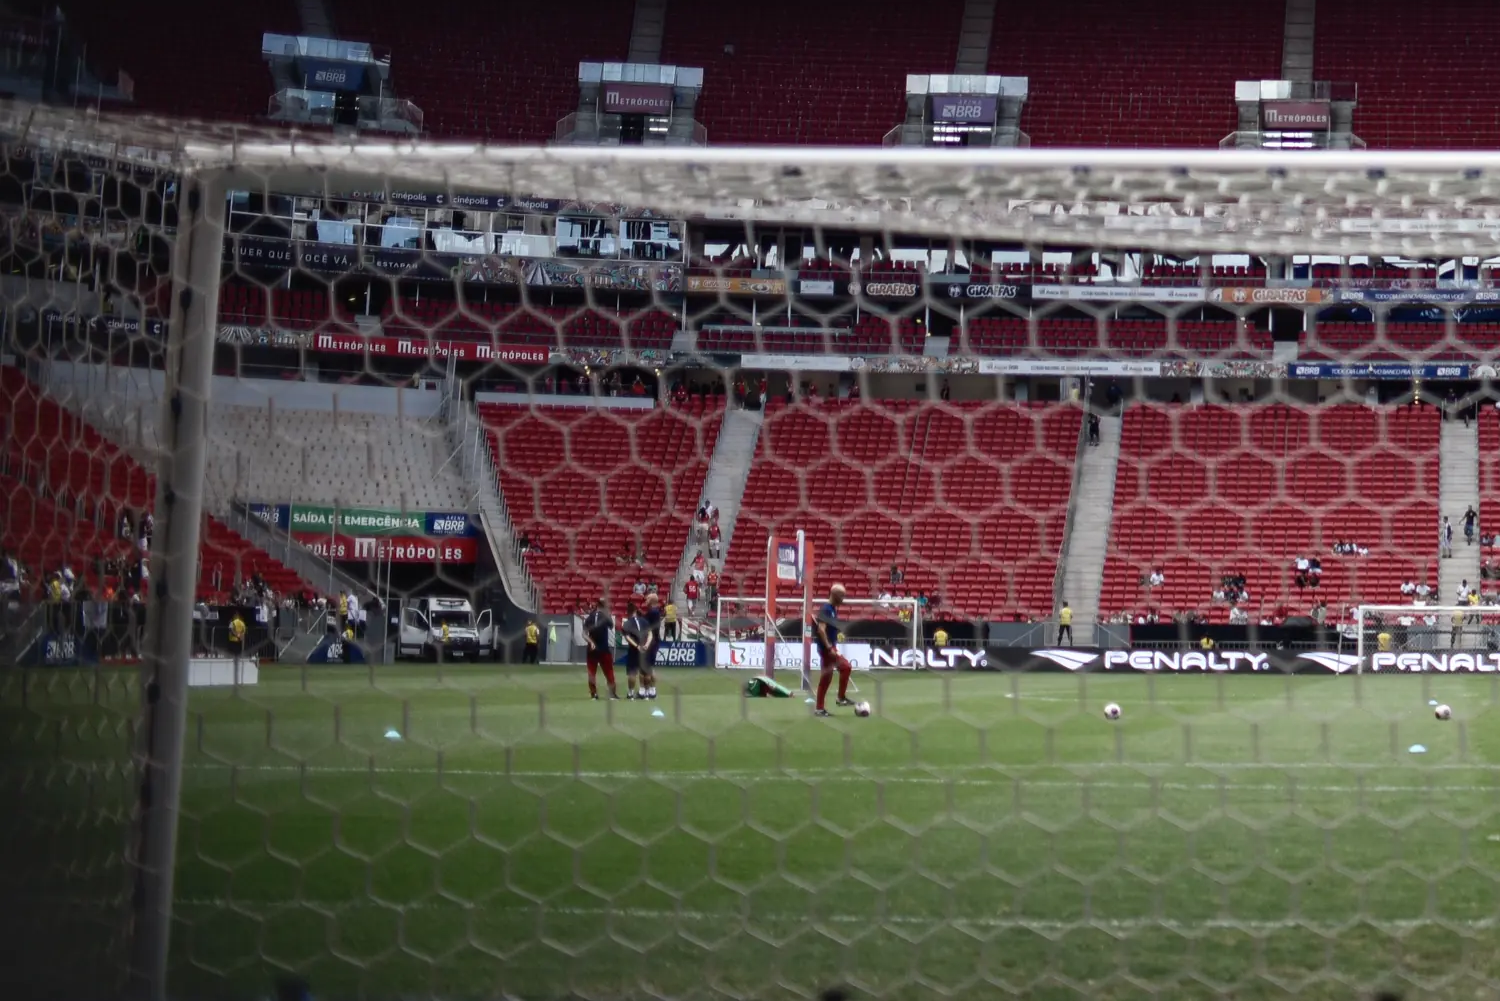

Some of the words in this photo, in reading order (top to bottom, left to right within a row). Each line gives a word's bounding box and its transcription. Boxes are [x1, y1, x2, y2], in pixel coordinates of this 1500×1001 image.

[325, 72, 346, 83] BRB
[955, 105, 982, 118] BRB
[1264, 109, 1327, 123] METRÓPOLES
[391, 191, 427, 202] cinépolis
[453, 197, 489, 206] cinépolis
[268, 250, 291, 260] QUE
[475, 345, 544, 361] METRÓPOLES
[293, 511, 326, 525] SAÍDA
[443, 520, 465, 531] BRB
[668, 648, 696, 662] BRB
[1104, 650, 1268, 671] PENALTY
